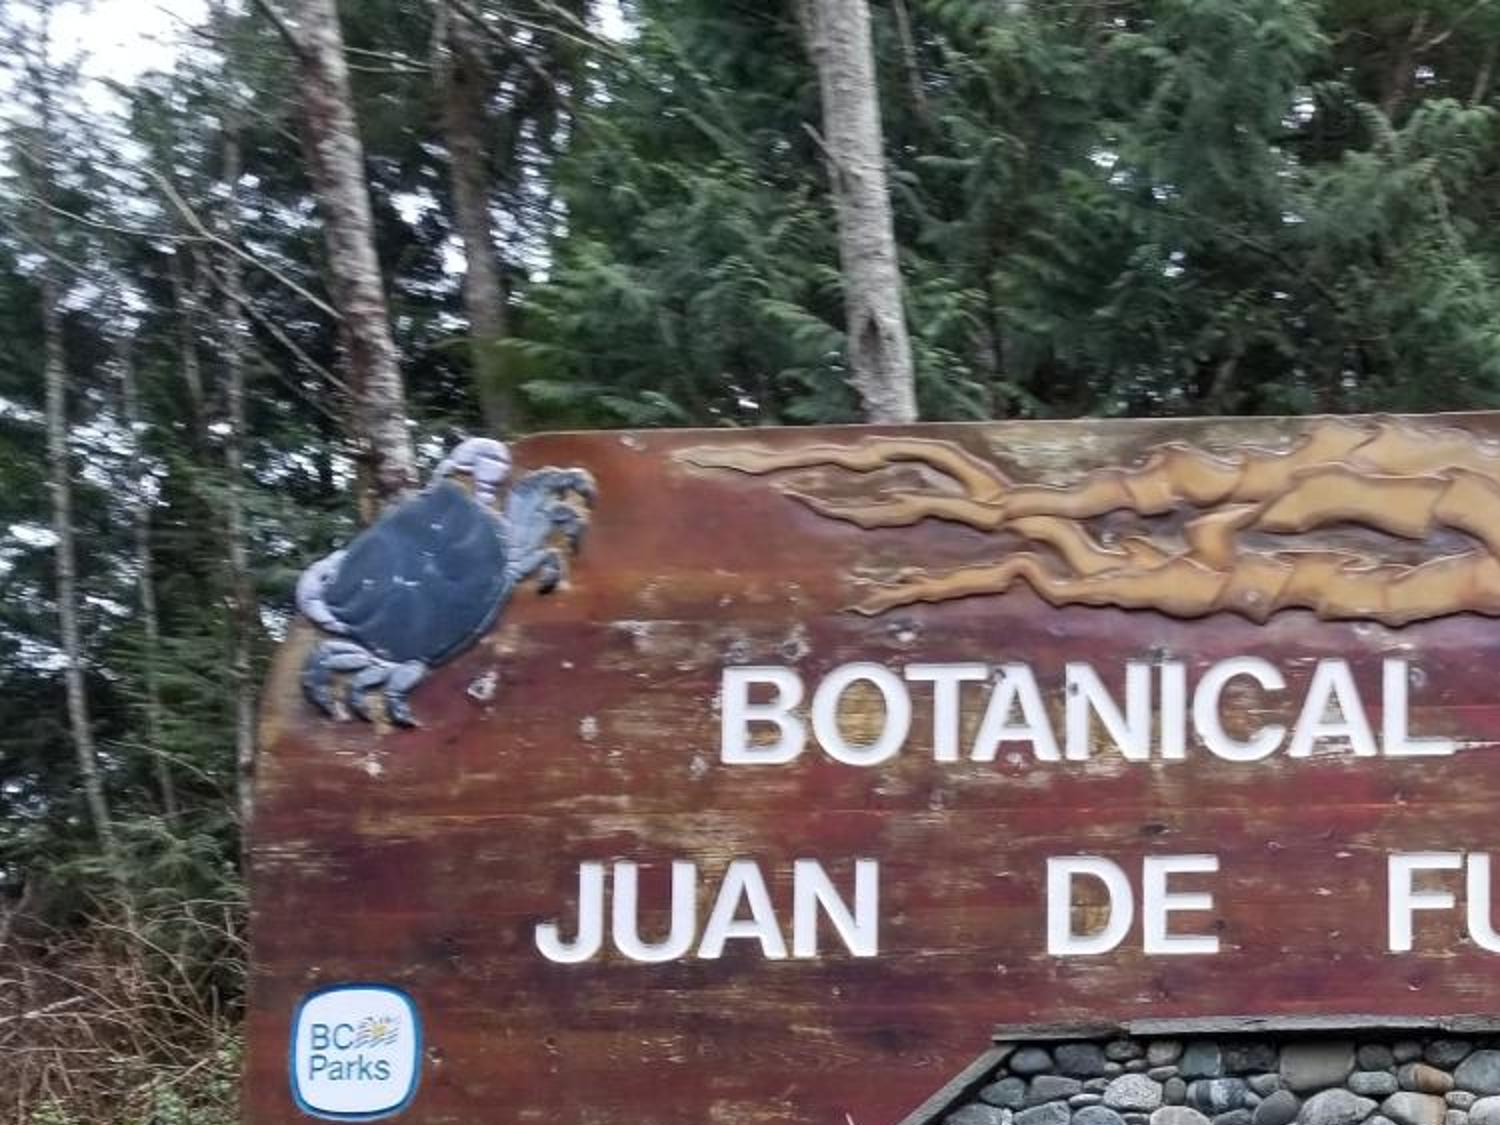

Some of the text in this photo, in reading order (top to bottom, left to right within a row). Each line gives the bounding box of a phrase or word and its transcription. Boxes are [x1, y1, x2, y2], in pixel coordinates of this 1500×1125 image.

[719, 655, 1456, 766] BOTANICAL
[535, 858, 880, 964] JUAN
[1045, 854, 1221, 956] DE
[308, 1053, 391, 1081] Parks
[310, 1023, 355, 1050] BC
